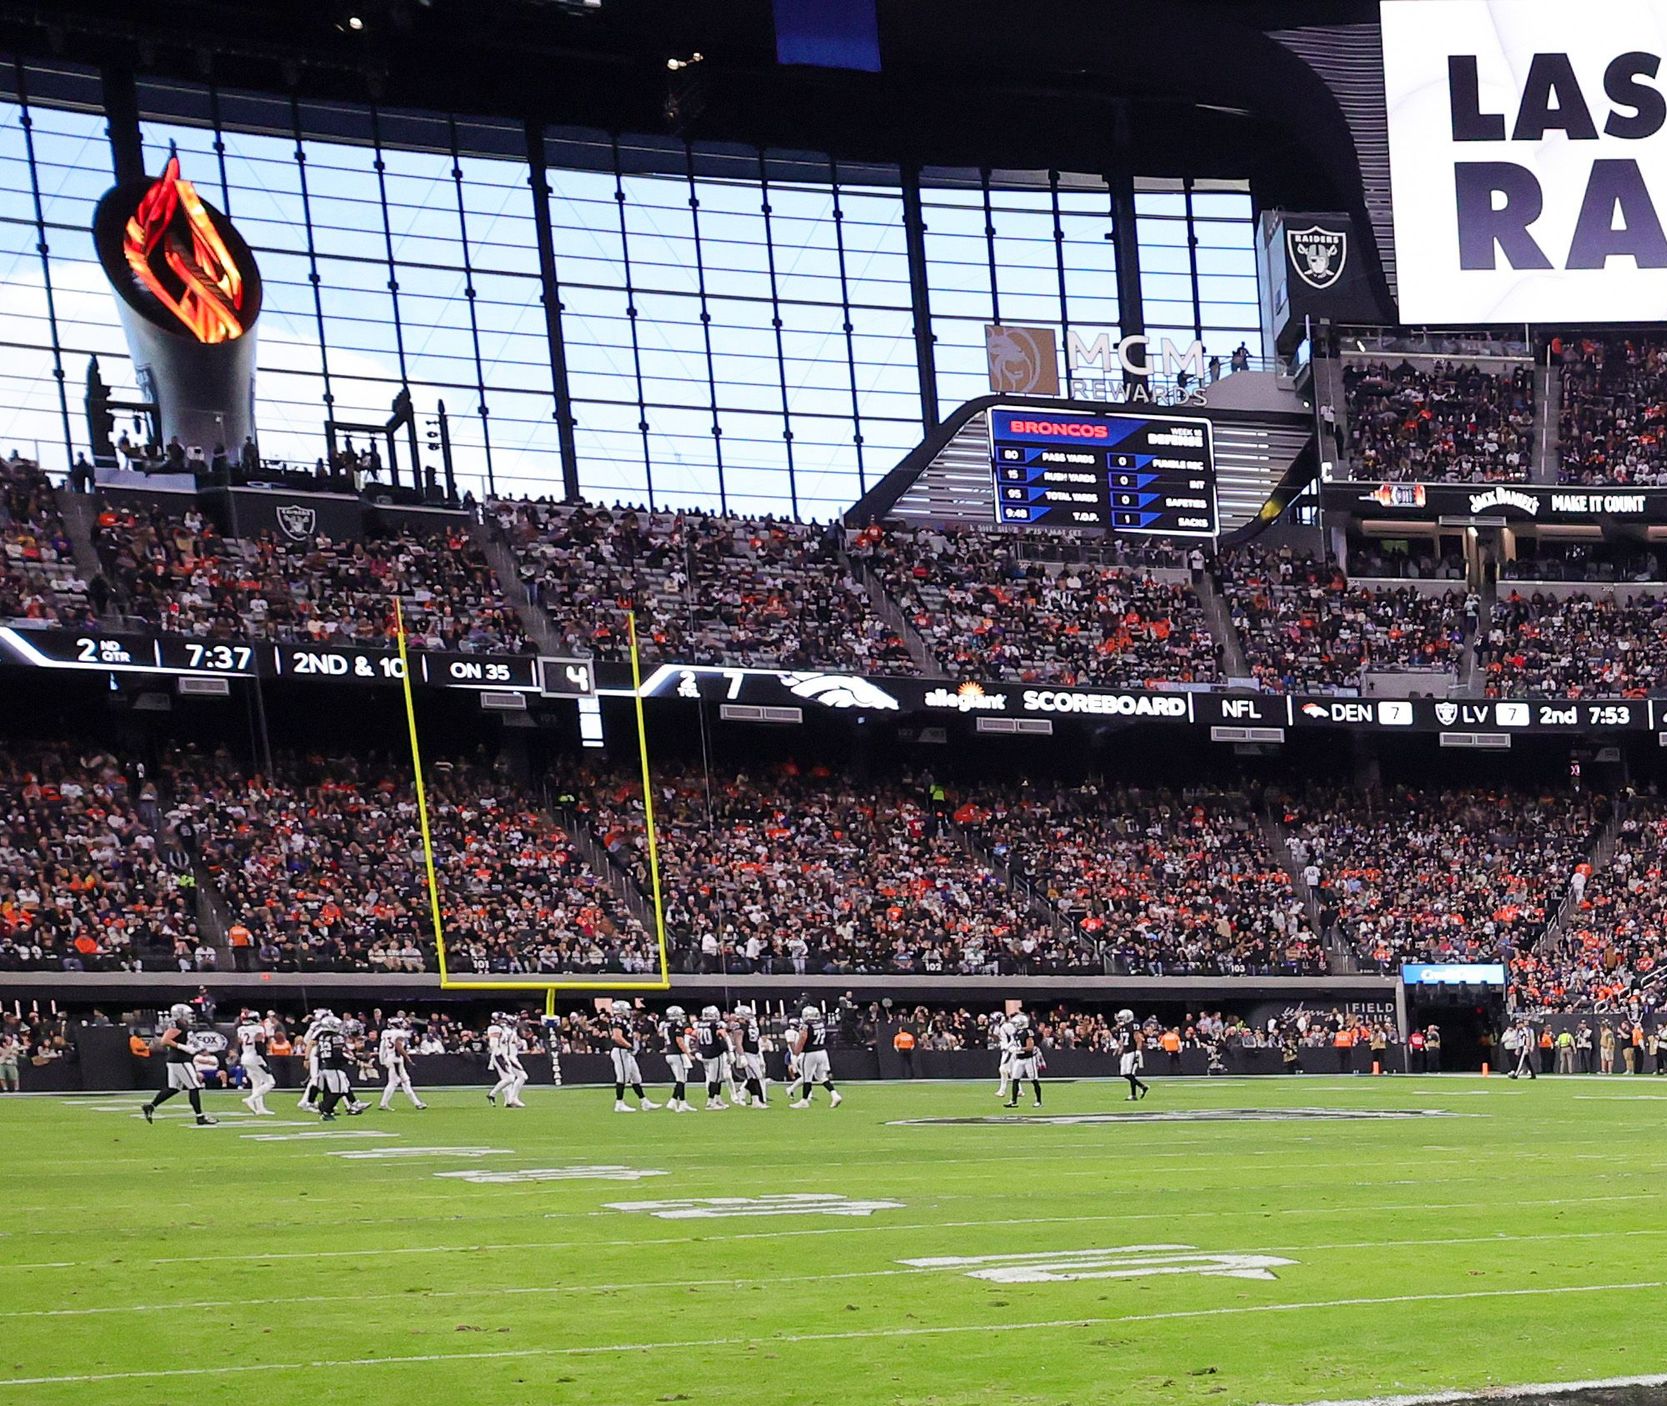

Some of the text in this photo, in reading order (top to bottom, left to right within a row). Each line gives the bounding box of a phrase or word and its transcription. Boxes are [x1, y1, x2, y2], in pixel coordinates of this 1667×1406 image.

[1448, 52, 1667, 141] LAS
[1295, 234, 1339, 244] RAIDERS
[1067, 331, 1204, 379] MGM
[1070, 379, 1209, 408] REWARDS
[1010, 420, 1109, 439] BRONCOS
[1118, 457, 1127, 467] 0
[1120, 476, 1129, 486] 0
[1121, 496, 1130, 505] 0
[1551, 495, 1588, 512] MAKE
[1589, 496, 1603, 513] IT
[1603, 495, 1646, 513] COUNT
[76, 637, 98, 662] 2
[100, 640, 119, 651] ND
[101, 650, 131, 663] QTR
[185, 643, 254, 670] 7:37
[292, 652, 347, 676] 2ND
[354, 655, 375, 677] &
[450, 661, 482, 680] ON
[485, 664, 512, 681] 35
[679, 670, 696, 688] 2
[722, 672, 744, 699] 7
[924, 688, 1006, 712] allegiant
[1023, 689, 1187, 717] SCOREBOARD
[1222, 699, 1262, 720] NFL
[1330, 702, 1400, 723] DEN 7
[1461, 704, 1517, 724] LV 7
[1539, 706, 1630, 725] 2nd 7:53
[925, 963, 942, 971] 102
[1230, 965, 1244, 973] 103
[1351, 1003, 1394, 1013] FIELD
